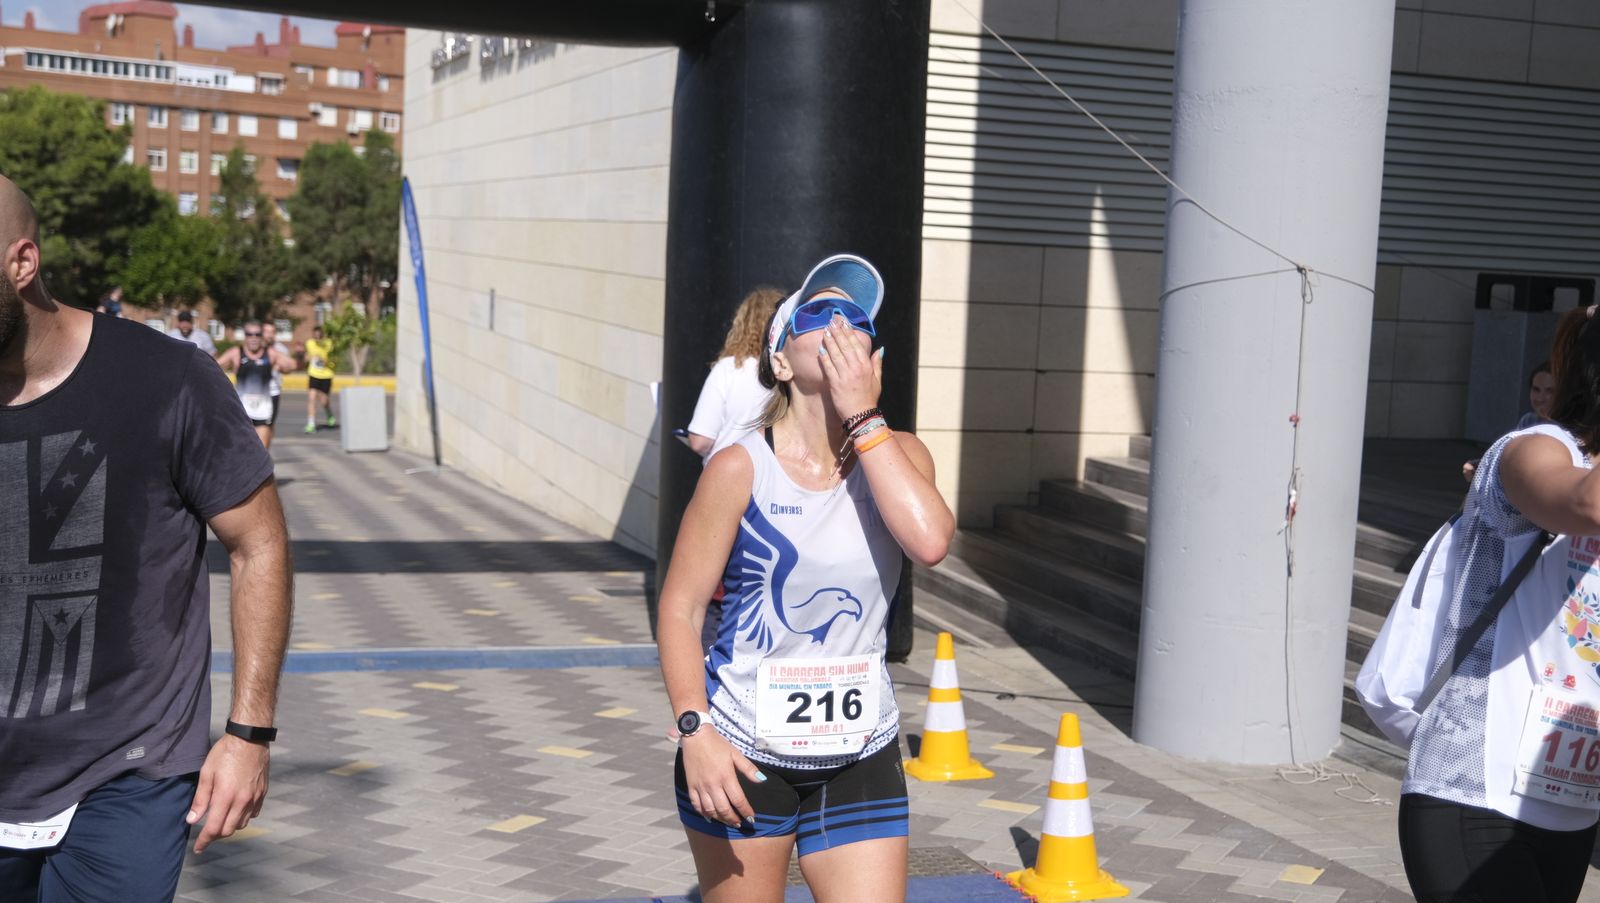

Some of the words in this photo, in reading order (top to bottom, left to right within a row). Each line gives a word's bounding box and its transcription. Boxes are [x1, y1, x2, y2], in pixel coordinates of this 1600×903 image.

[770, 666, 777, 677] II
[780, 666, 826, 677] CARRERA
[828, 665, 845, 676] SIN
[847, 662, 869, 675] HUMO
[786, 688, 863, 723] 216
[1543, 730, 1600, 772] 116
